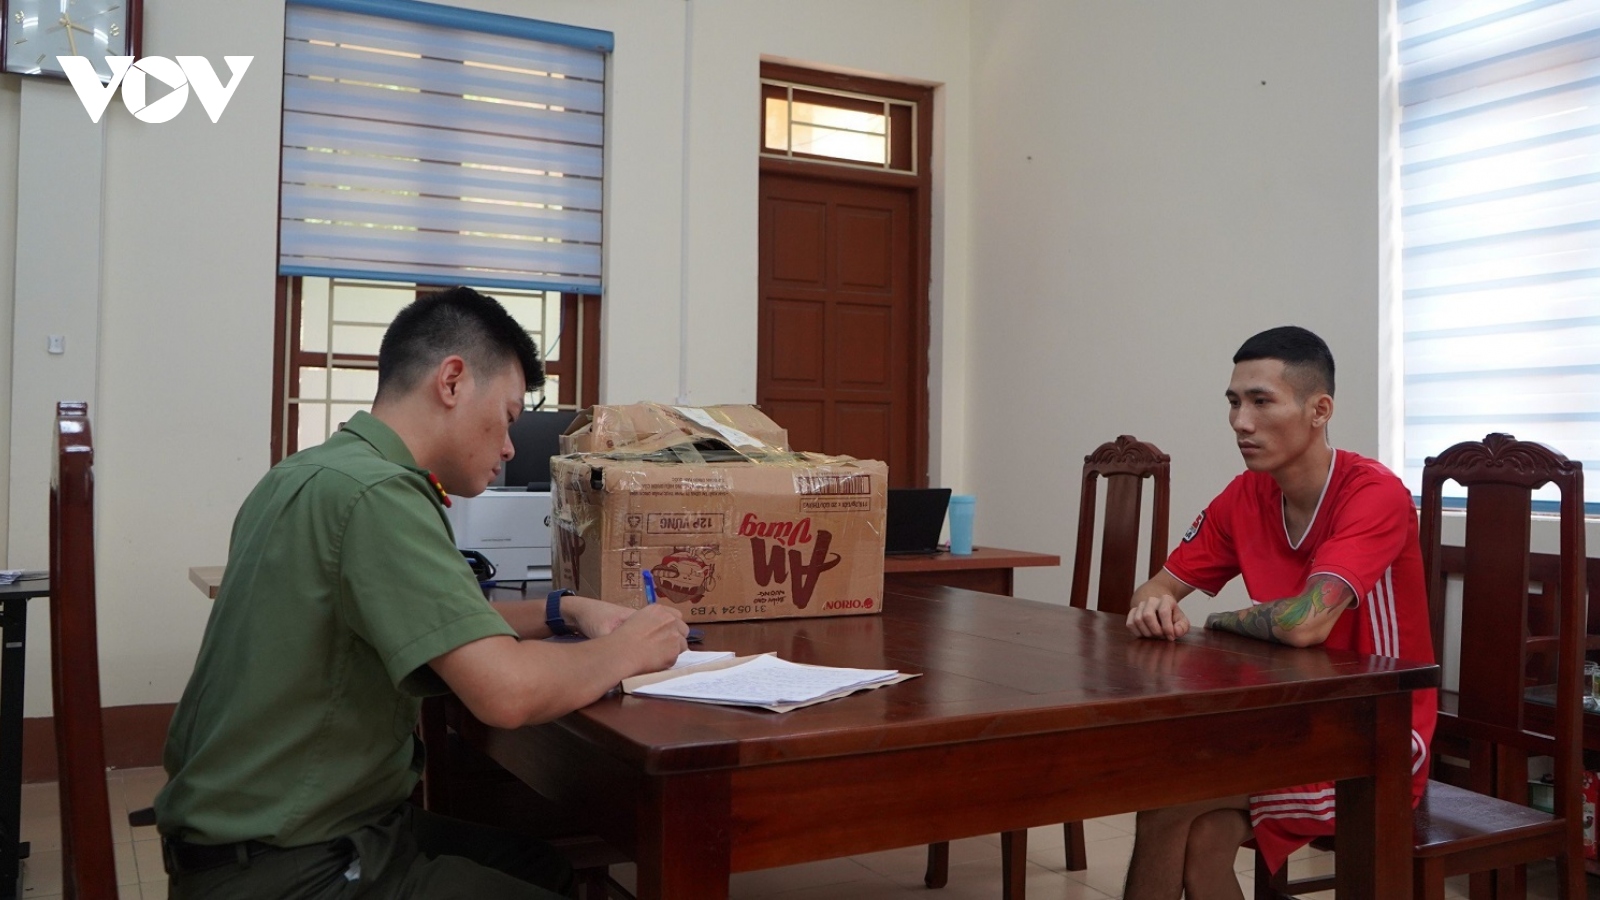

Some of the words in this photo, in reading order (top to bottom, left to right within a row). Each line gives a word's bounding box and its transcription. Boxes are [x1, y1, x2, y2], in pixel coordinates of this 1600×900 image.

[660, 517, 690, 531] VỪNG
[693, 517, 712, 528] 12P
[738, 513, 812, 546] Vừng
[750, 530, 841, 609] An
[690, 607, 706, 615] B3
[708, 607, 717, 615] Y
[721, 606, 735, 614] 24
[737, 605, 751, 614] 05
[755, 605, 766, 613] 31
